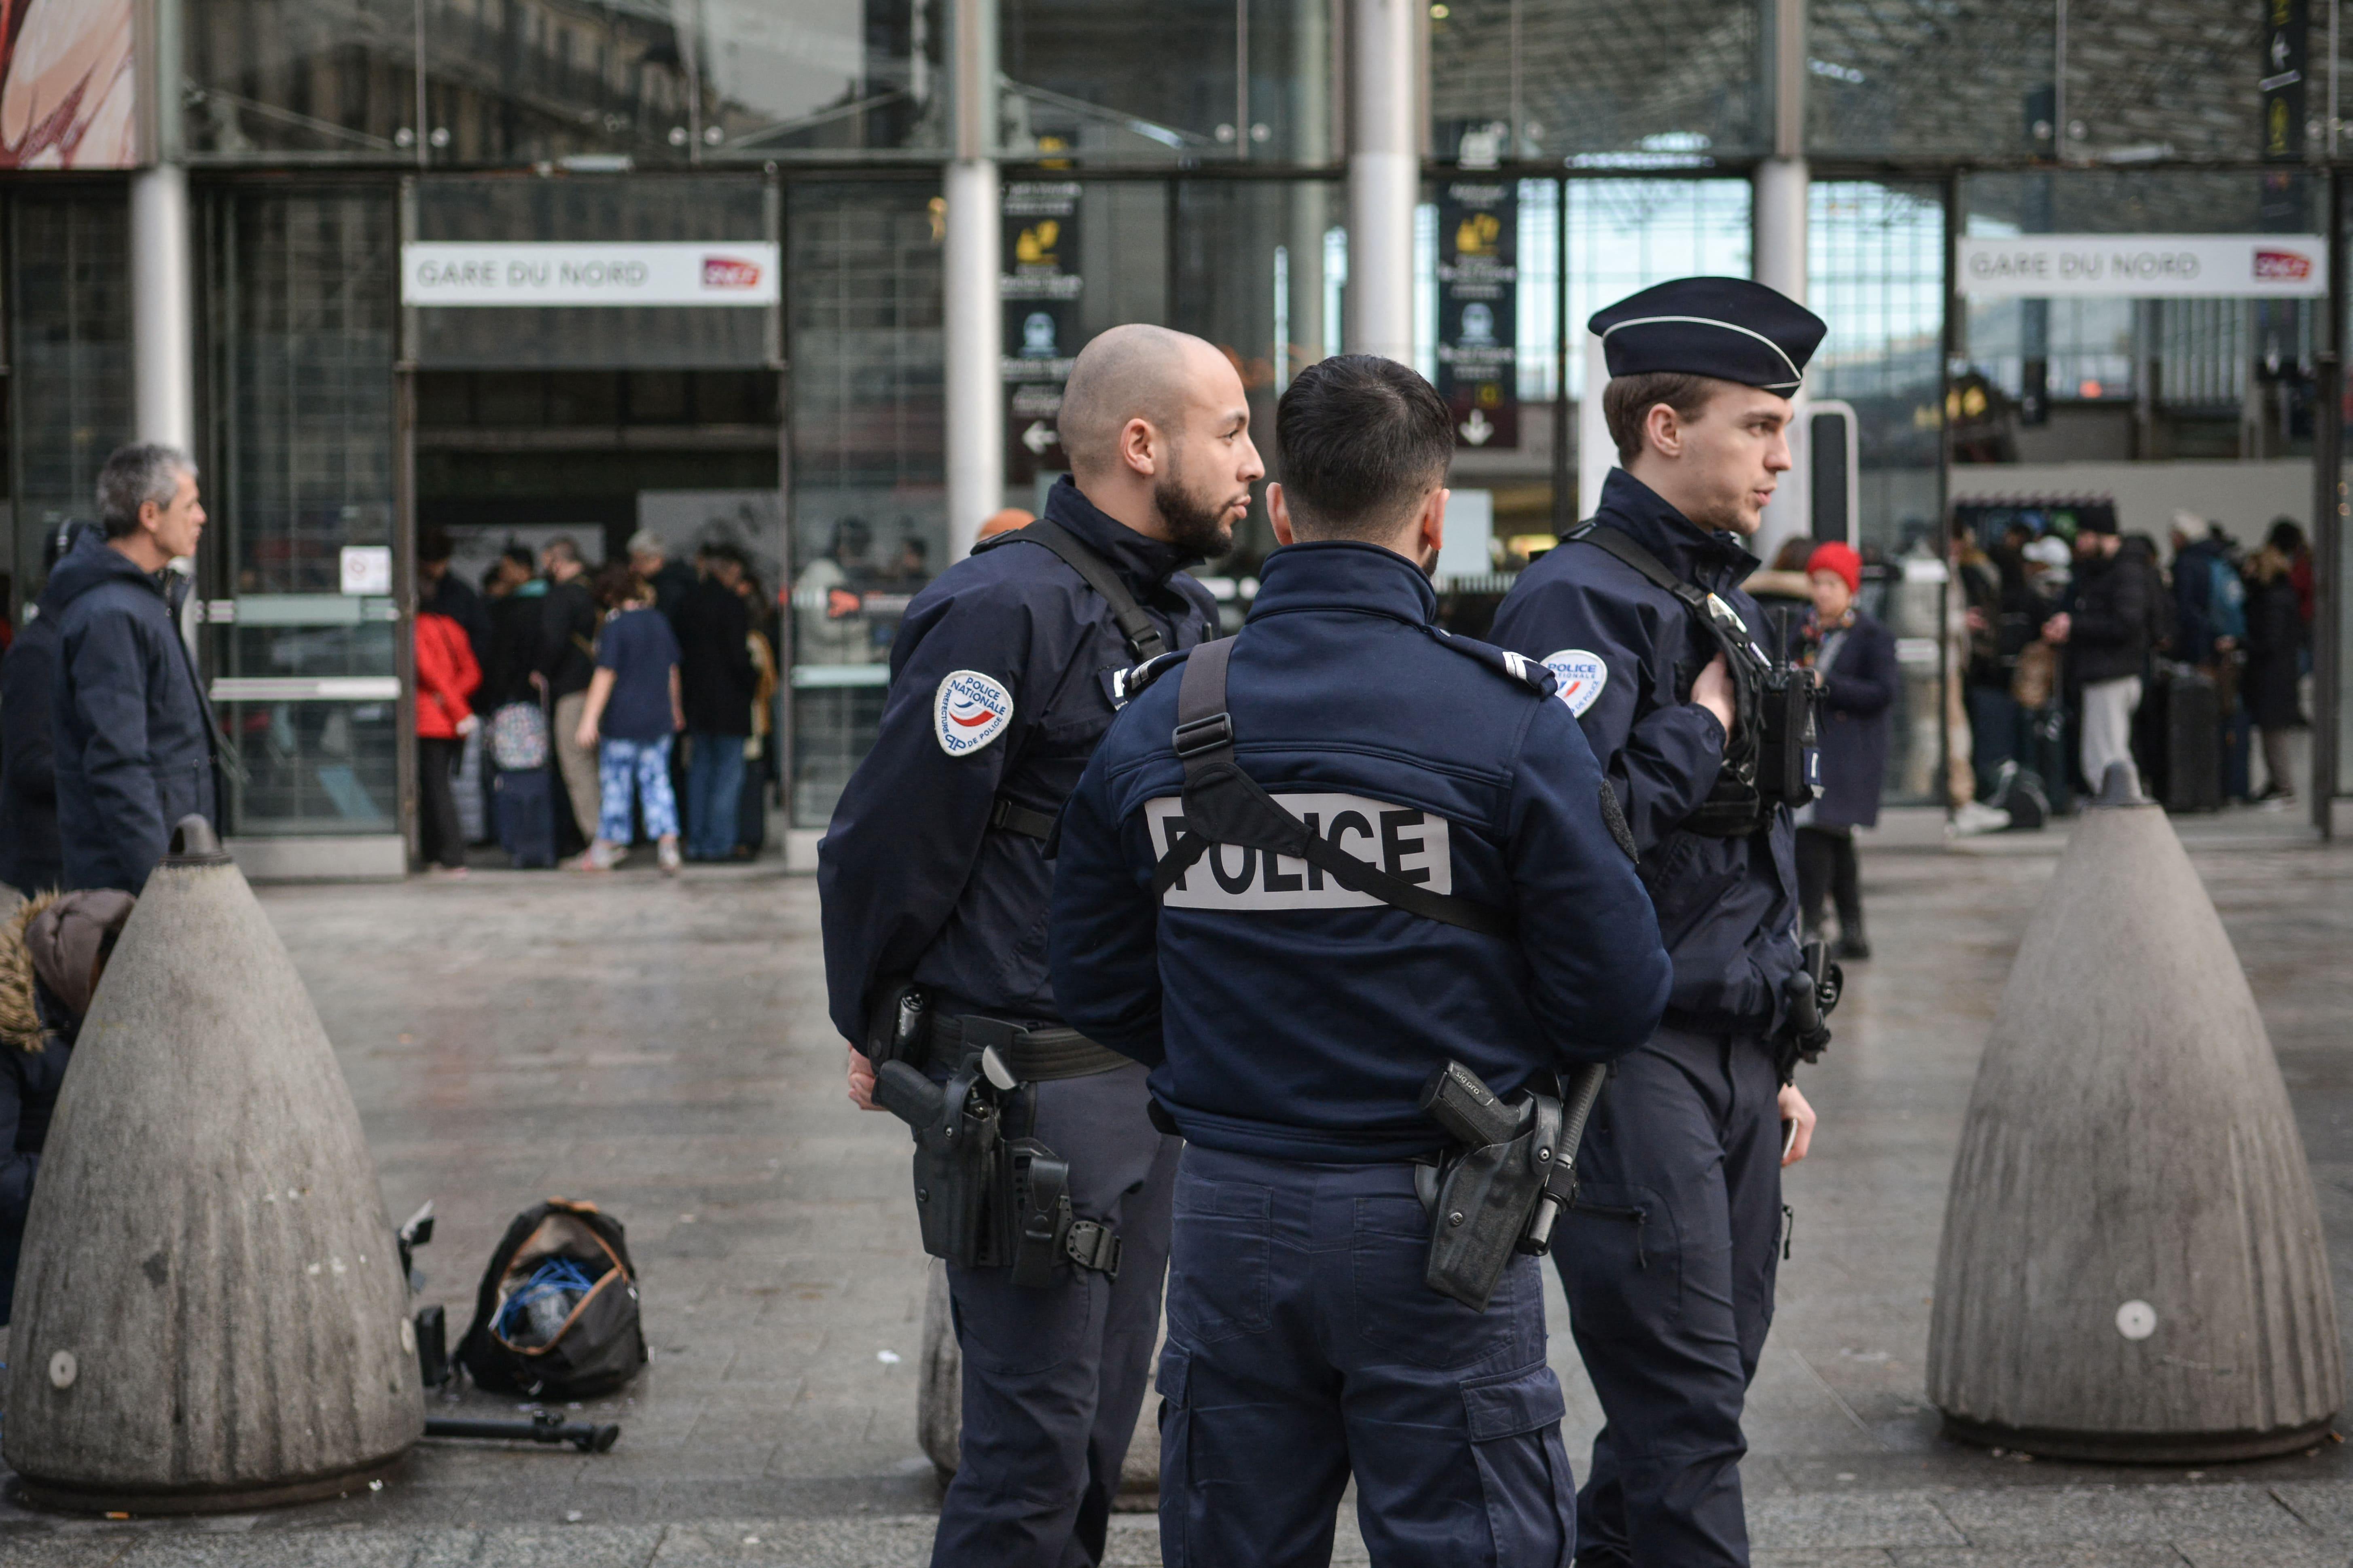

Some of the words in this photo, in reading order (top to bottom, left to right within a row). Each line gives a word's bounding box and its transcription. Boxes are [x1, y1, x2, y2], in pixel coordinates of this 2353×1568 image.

[418, 260, 499, 288] GARE
[507, 260, 551, 288] DU
[560, 260, 649, 288] NORD
[1969, 251, 2050, 281] GARE
[2059, 252, 2103, 281] DU
[2111, 251, 2202, 281] NORD
[1548, 663, 1597, 673] POLICE
[951, 680, 1006, 715] NATIONALE
[966, 677, 1000, 700] POLICE
[1582, 680, 1599, 701] POLICE
[941, 688, 952, 734] PREFECTURE
[968, 737, 978, 747] DE
[979, 716, 1002, 740] POLICE
[1455, 1071, 1468, 1083] sig
[1464, 1081, 1480, 1094] pro
